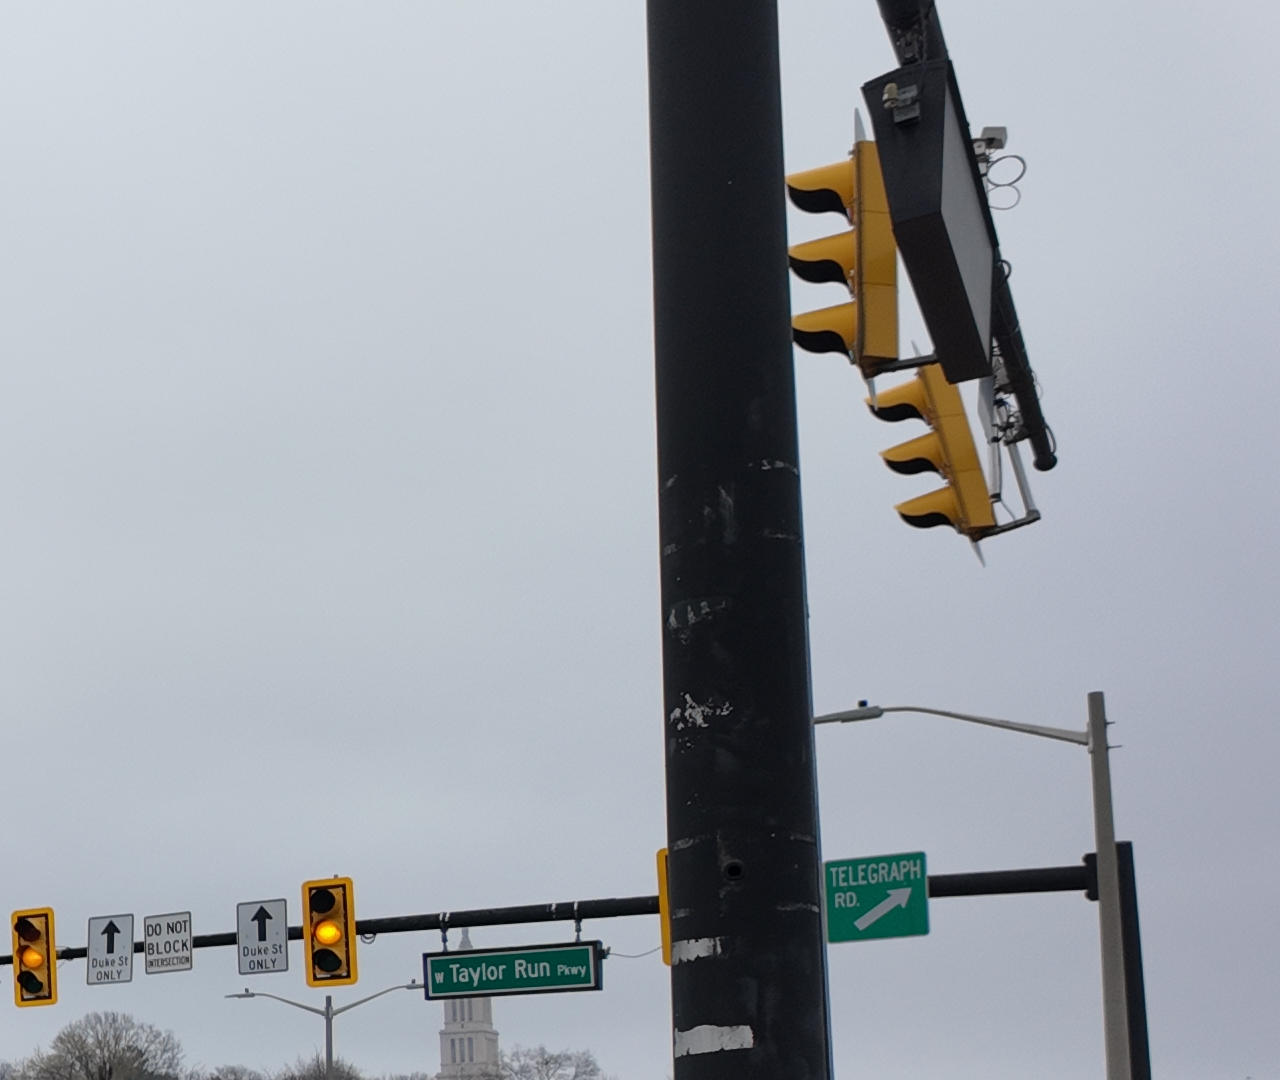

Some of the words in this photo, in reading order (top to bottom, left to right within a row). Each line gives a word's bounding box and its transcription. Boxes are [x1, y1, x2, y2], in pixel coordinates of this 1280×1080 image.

[830, 859, 920, 887] TELEGRAPH
[835, 891, 860, 908] RD.
[147, 923, 162, 937] DO
[167, 920, 188, 935] NOT
[147, 939, 189, 956] BLOCK
[243, 945, 269, 957] Duke
[272, 943, 283, 954] St
[92, 958, 115, 968] Duke
[118, 956, 129, 966] St
[148, 956, 190, 968] INTERSECTION
[249, 958, 277, 971] ONLY
[96, 970, 122, 981] ONLY
[434, 971, 444, 984] W
[449, 963, 507, 987] Taylor
[514, 959, 551, 979] Run
[557, 964, 587, 978] Pkwy
